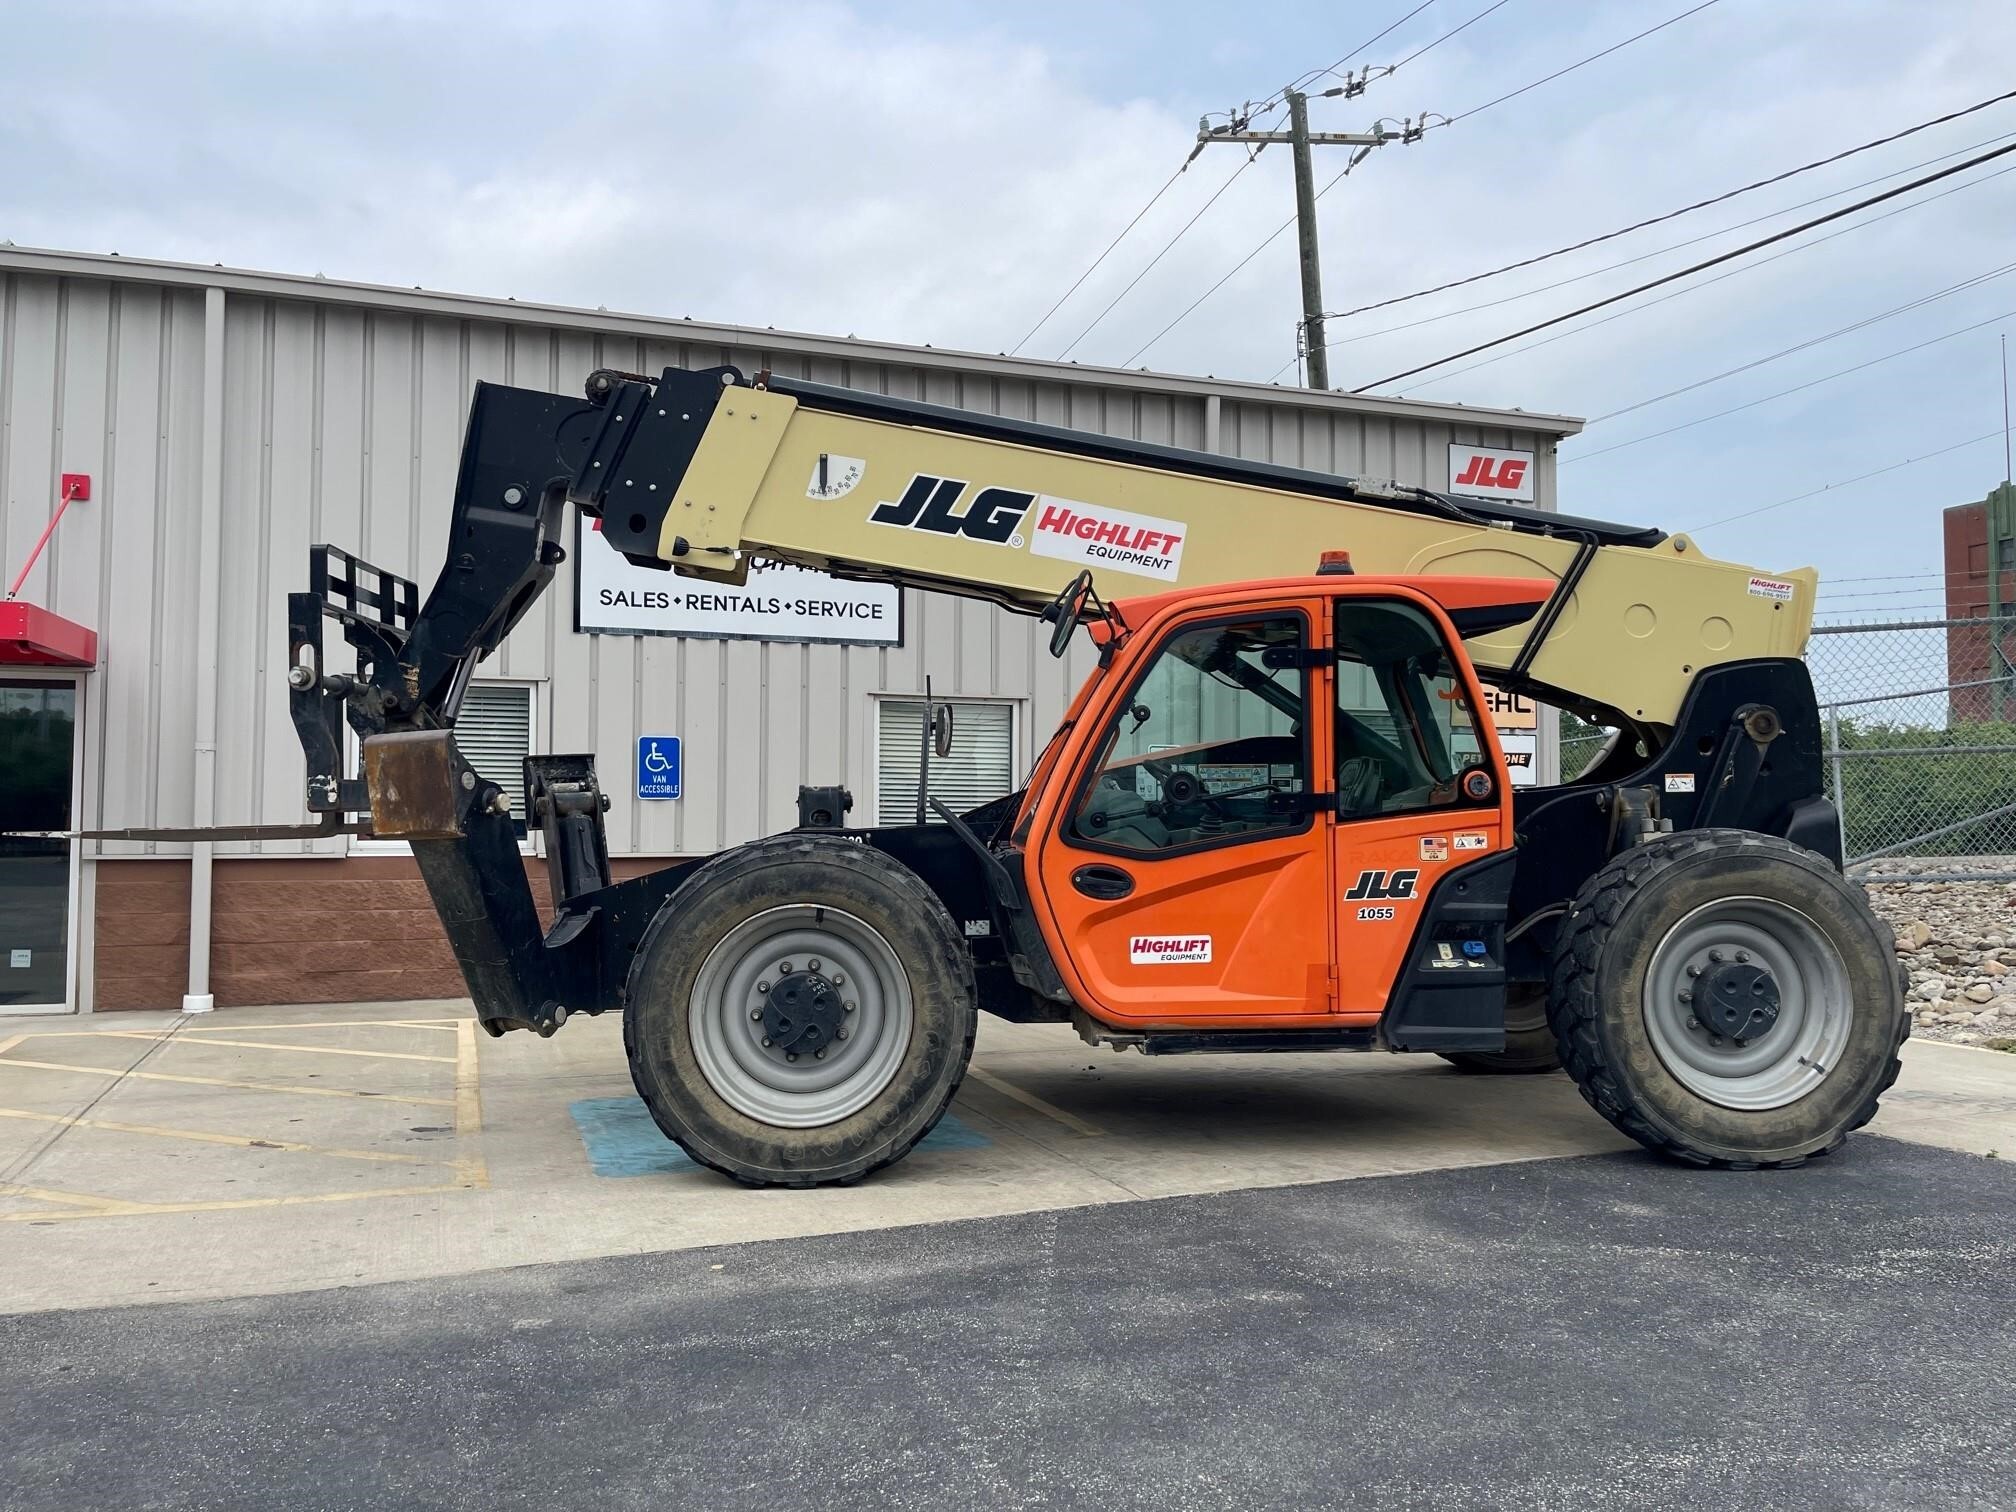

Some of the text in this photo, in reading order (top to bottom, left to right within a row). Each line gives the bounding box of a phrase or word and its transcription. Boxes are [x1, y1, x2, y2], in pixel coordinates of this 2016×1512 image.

[1455, 455, 1529, 490] JLG
[868, 473, 1037, 544] JLG
[1037, 505, 1183, 556] HIGHLIFT
[1086, 544, 1173, 571] EQUIPMENT
[1750, 579, 1792, 590] HIGHLIFT
[600, 589, 883, 620] SALES RENTALS SERVICE
[640, 785, 679, 793] ACCESSIBLE
[653, 775, 667, 783] VAN
[1345, 870, 1419, 900] JLG
[1359, 908, 1393, 919] 1055
[1132, 938, 1210, 953] HIGHLIFT
[1160, 953, 1208, 961] EQUIPMENT
